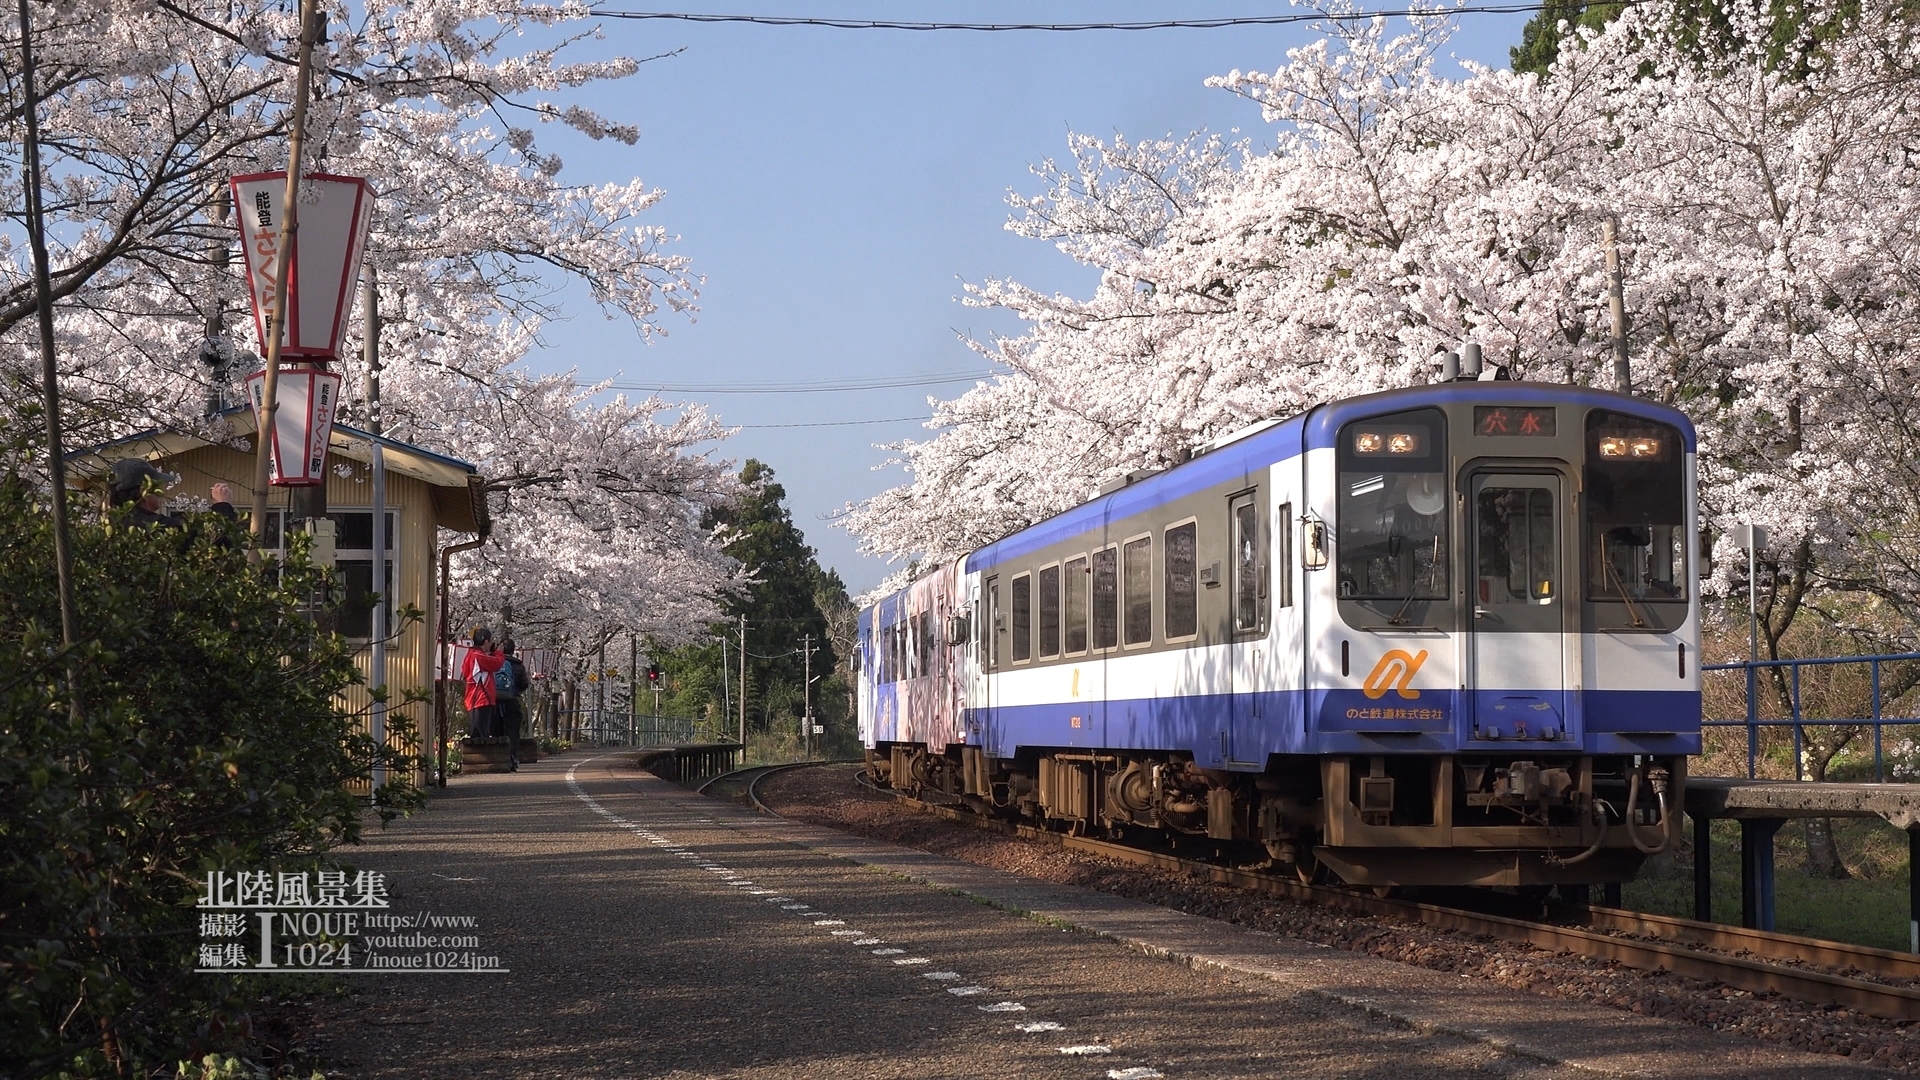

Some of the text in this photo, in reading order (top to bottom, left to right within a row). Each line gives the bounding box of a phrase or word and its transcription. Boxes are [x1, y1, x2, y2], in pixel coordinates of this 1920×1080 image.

[1485, 411, 1541, 434] 穴水
[1346, 707, 1443, 720] のと鉄道株式会社
